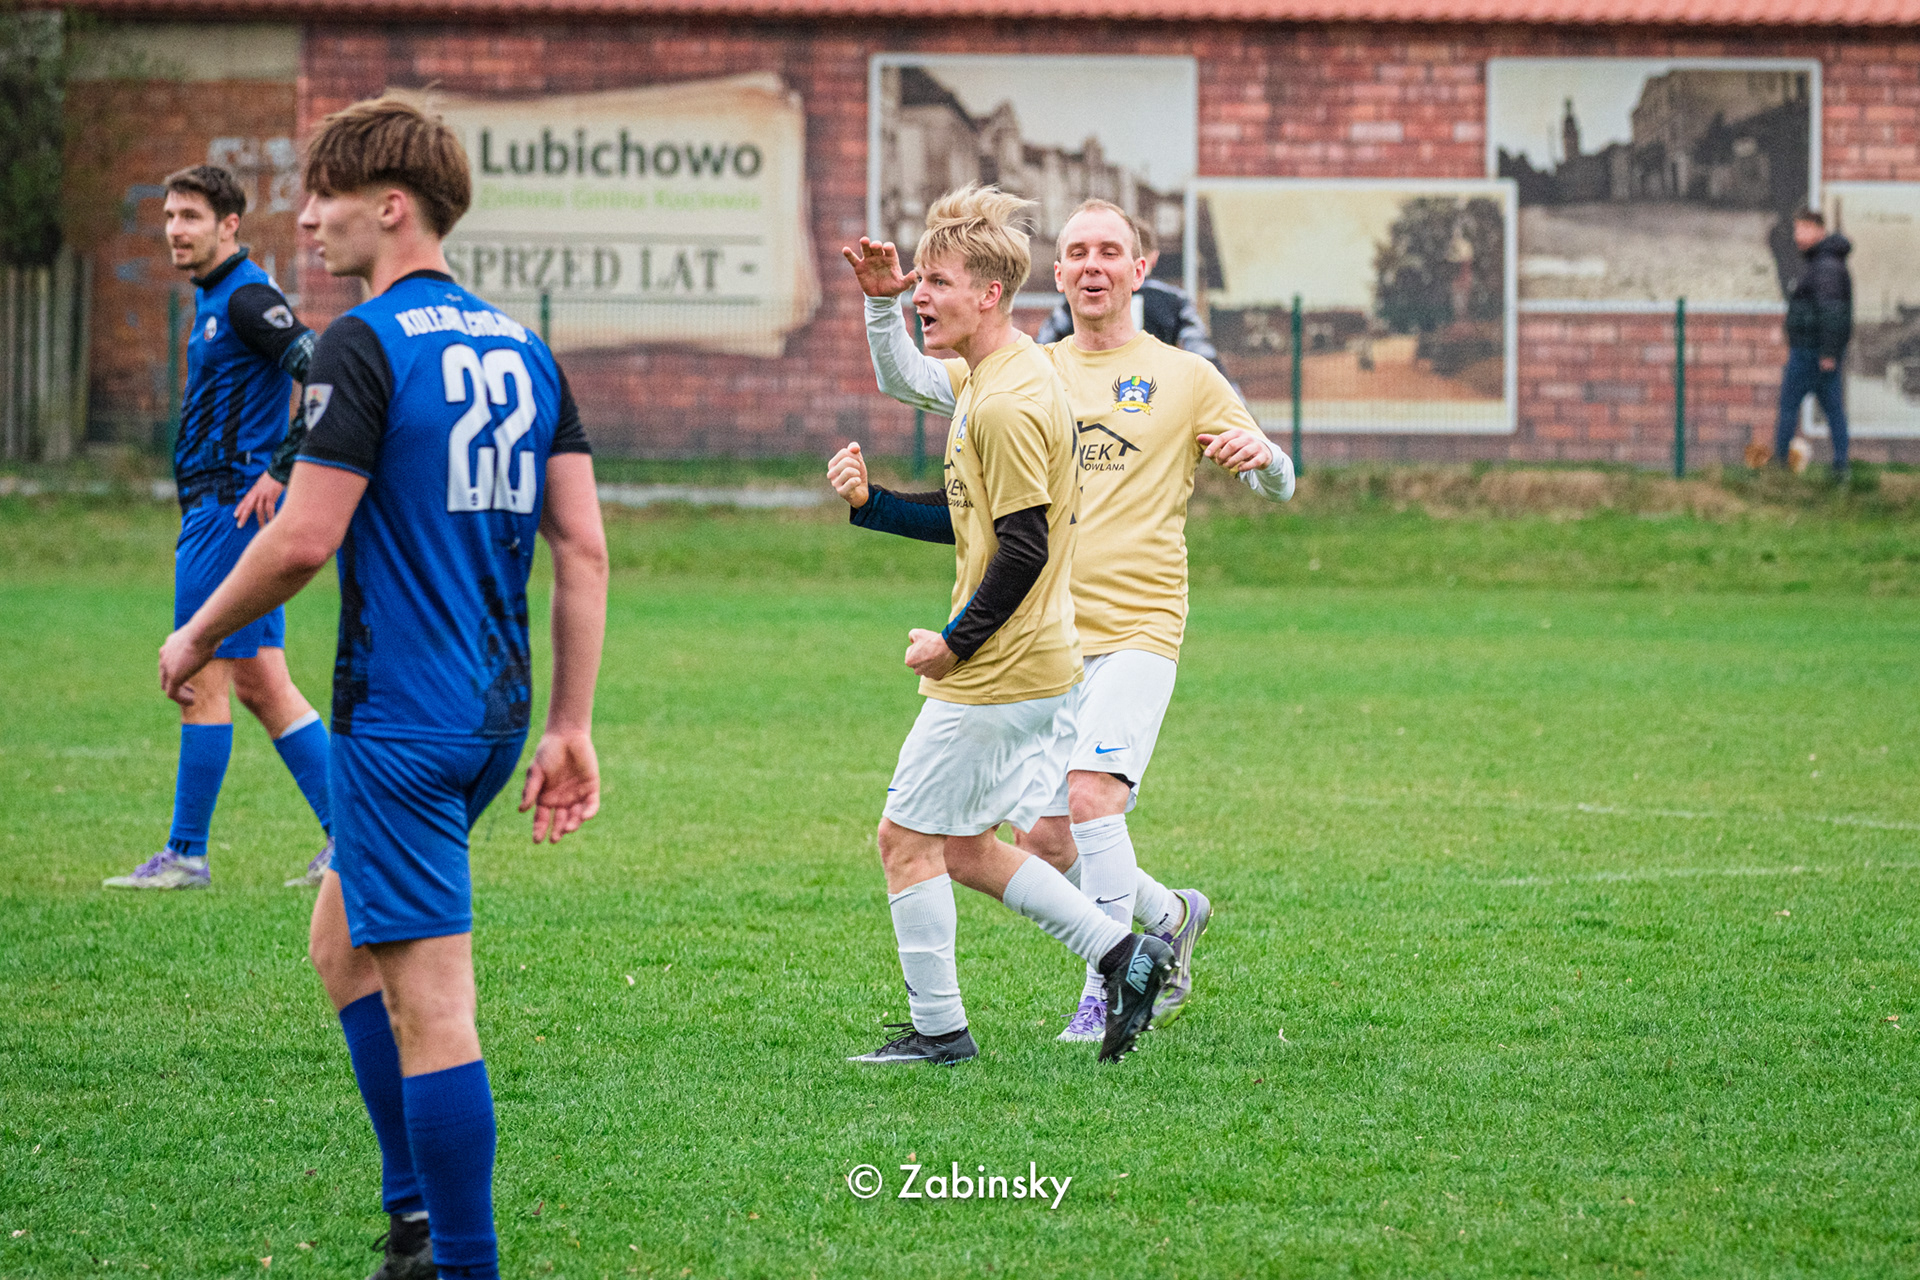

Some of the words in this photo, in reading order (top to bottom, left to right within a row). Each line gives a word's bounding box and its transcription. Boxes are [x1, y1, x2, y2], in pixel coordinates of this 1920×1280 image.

[480, 127, 763, 177] Lubichowo
[639, 247, 725, 291] LAT
[442, 343, 537, 514] 22
